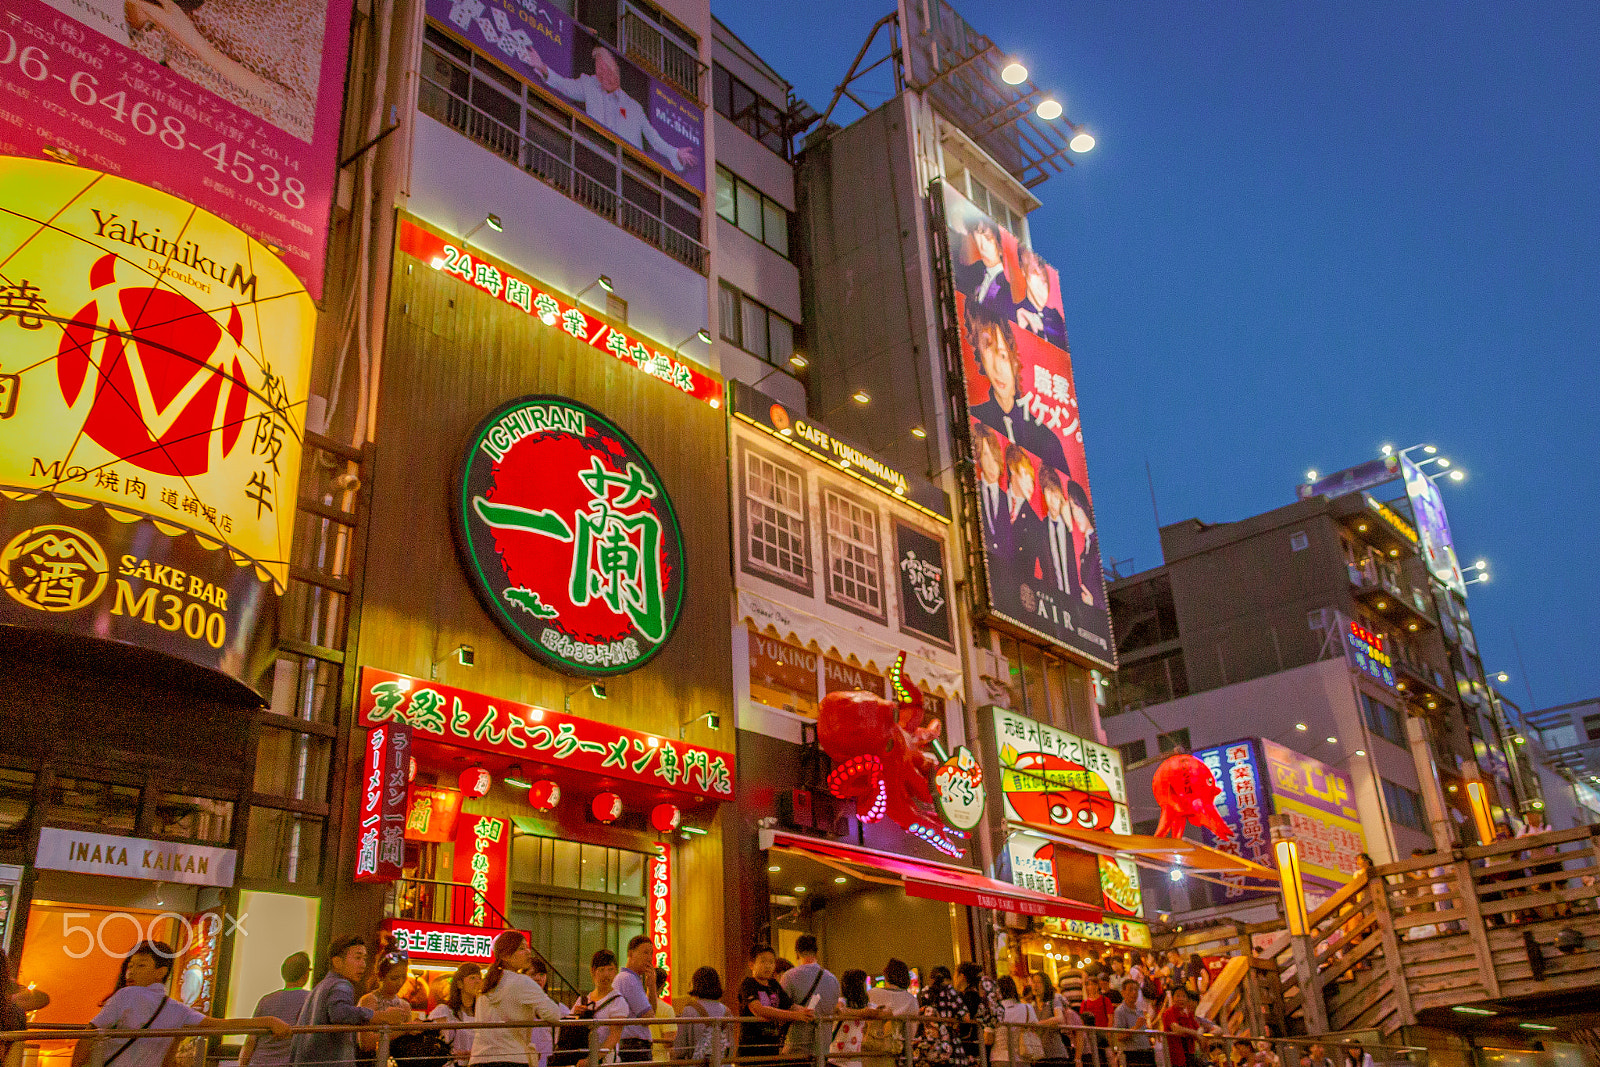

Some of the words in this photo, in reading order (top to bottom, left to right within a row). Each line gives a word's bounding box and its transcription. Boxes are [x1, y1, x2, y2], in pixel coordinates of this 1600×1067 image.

[518, 9, 562, 46] OSAKA
[90, 208, 227, 284] Yakiniku
[147, 258, 211, 294] Dotonbori
[245, 362, 290, 521] 松阪牛
[480, 406, 586, 463] ICHIRAN
[795, 420, 830, 451] CAFE
[829, 437, 908, 490] YUKINOHANA
[31, 458, 148, 500] Mの焼肉
[160, 486, 233, 534] 道頓堀店
[23, 553, 88, 607] 酒
[118, 554, 185, 593] SAKE
[188, 574, 229, 612] BAR
[473, 455, 666, 644] 一蘭
[110, 578, 227, 649] M300
[756, 637, 817, 673] YUKINO
[823, 664, 865, 690] HANA
[367, 681, 733, 795] 天然とんこつラーメン専門店
[357, 728, 386, 876] ラーメン一蘭
[379, 731, 408, 869] ラーメン一蘭
[68, 841, 129, 867] INAKA
[142, 850, 210, 875] KAIKAN
[391, 928, 493, 957] お土産販売所
